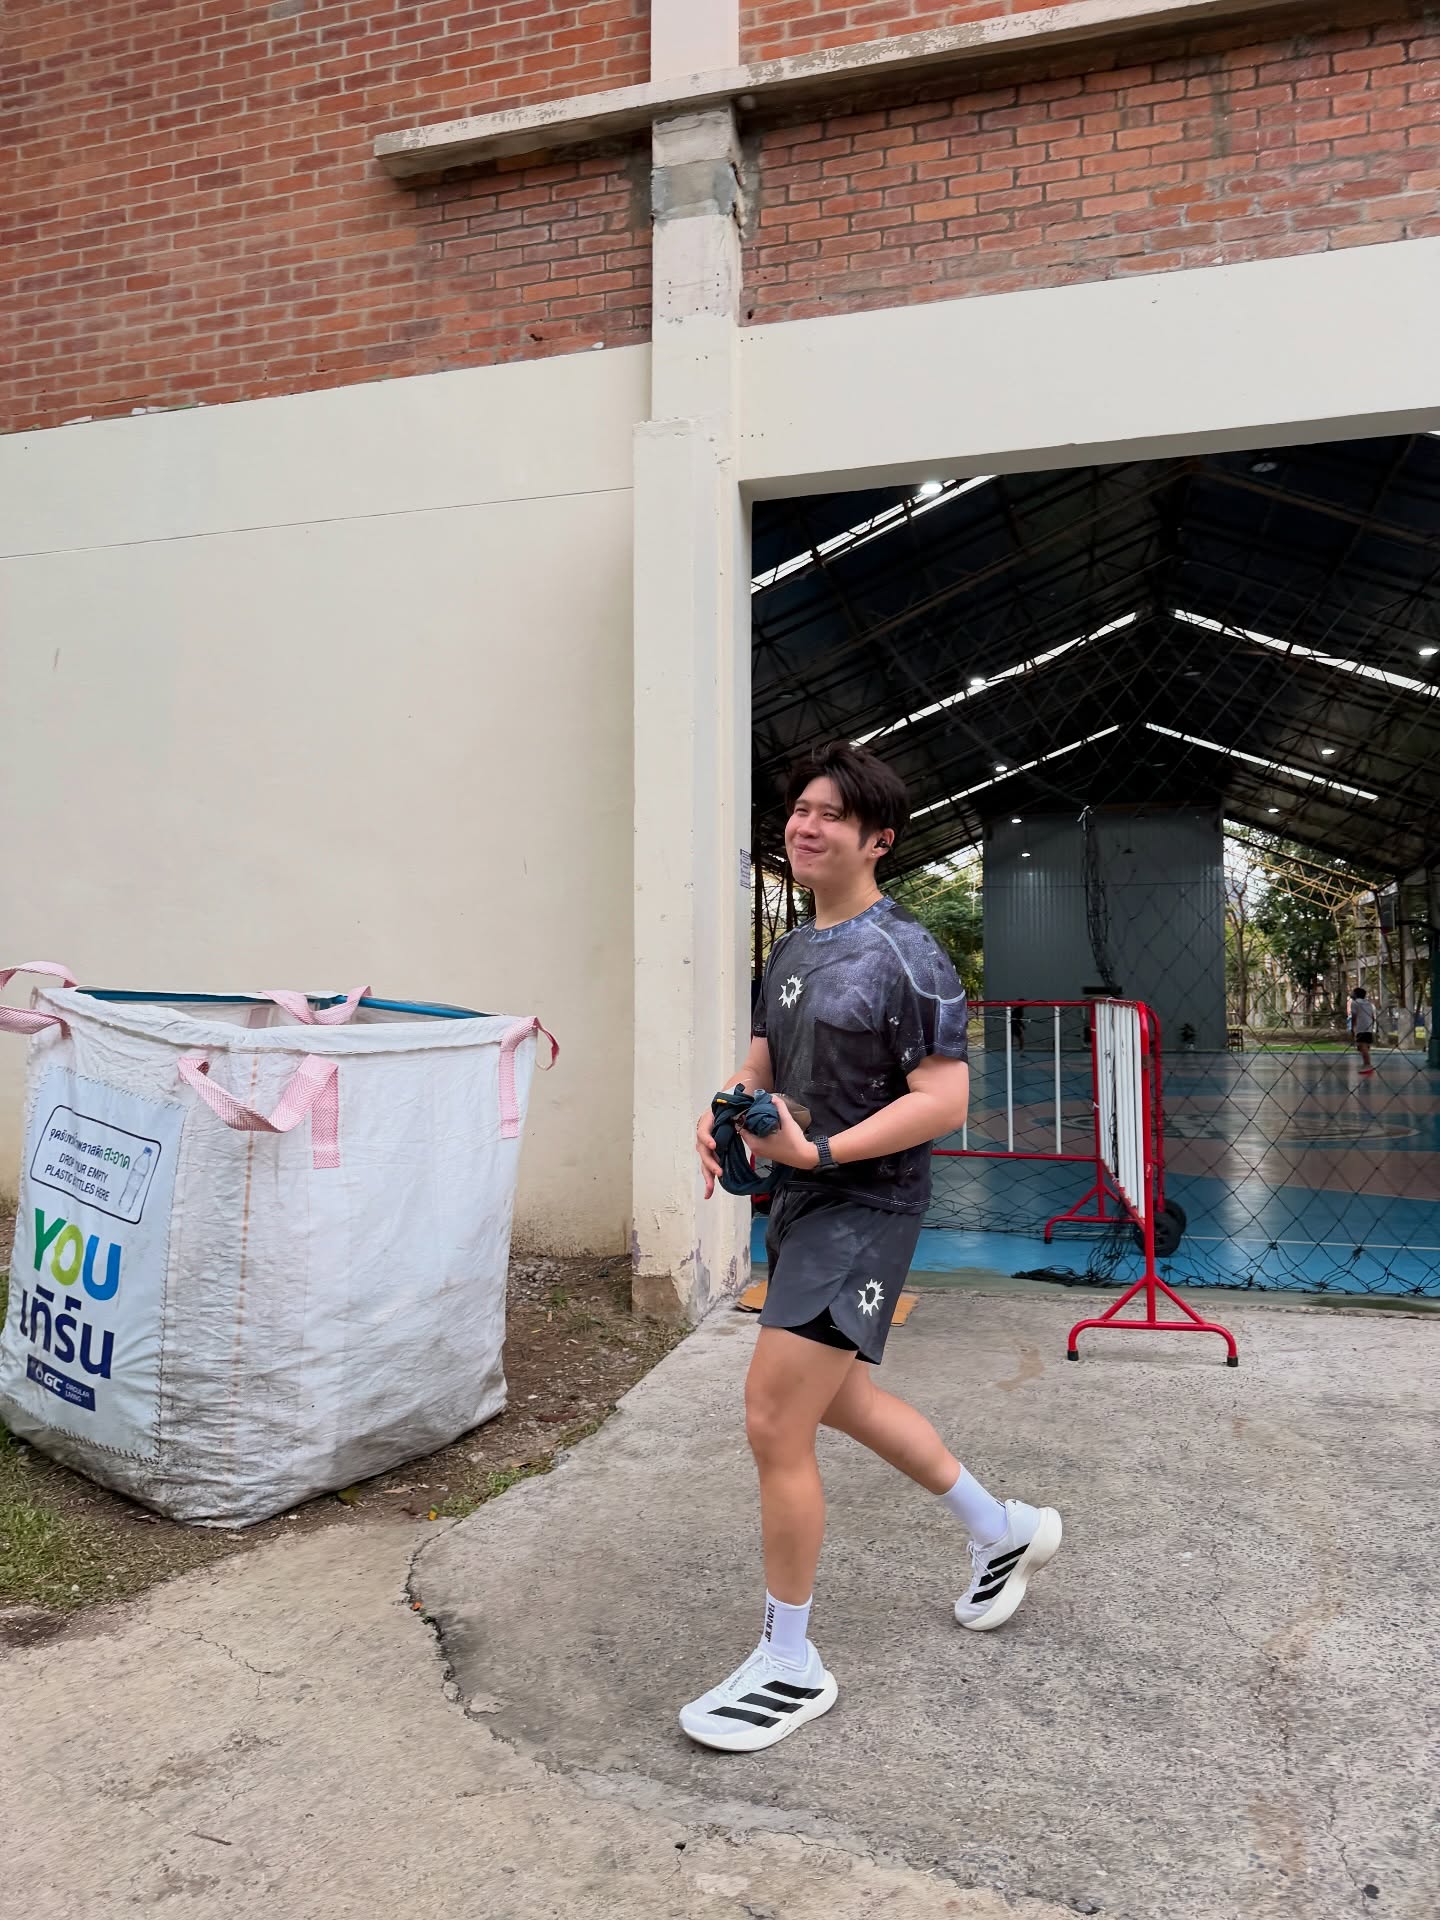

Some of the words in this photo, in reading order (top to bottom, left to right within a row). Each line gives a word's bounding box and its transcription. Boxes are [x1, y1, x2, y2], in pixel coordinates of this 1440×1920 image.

[94, 1186, 110, 1202] HERE
[34, 1207, 122, 1301] YOU
[19, 1283, 115, 1379] เทิร์น
[43, 1372, 63, 1392] GC
